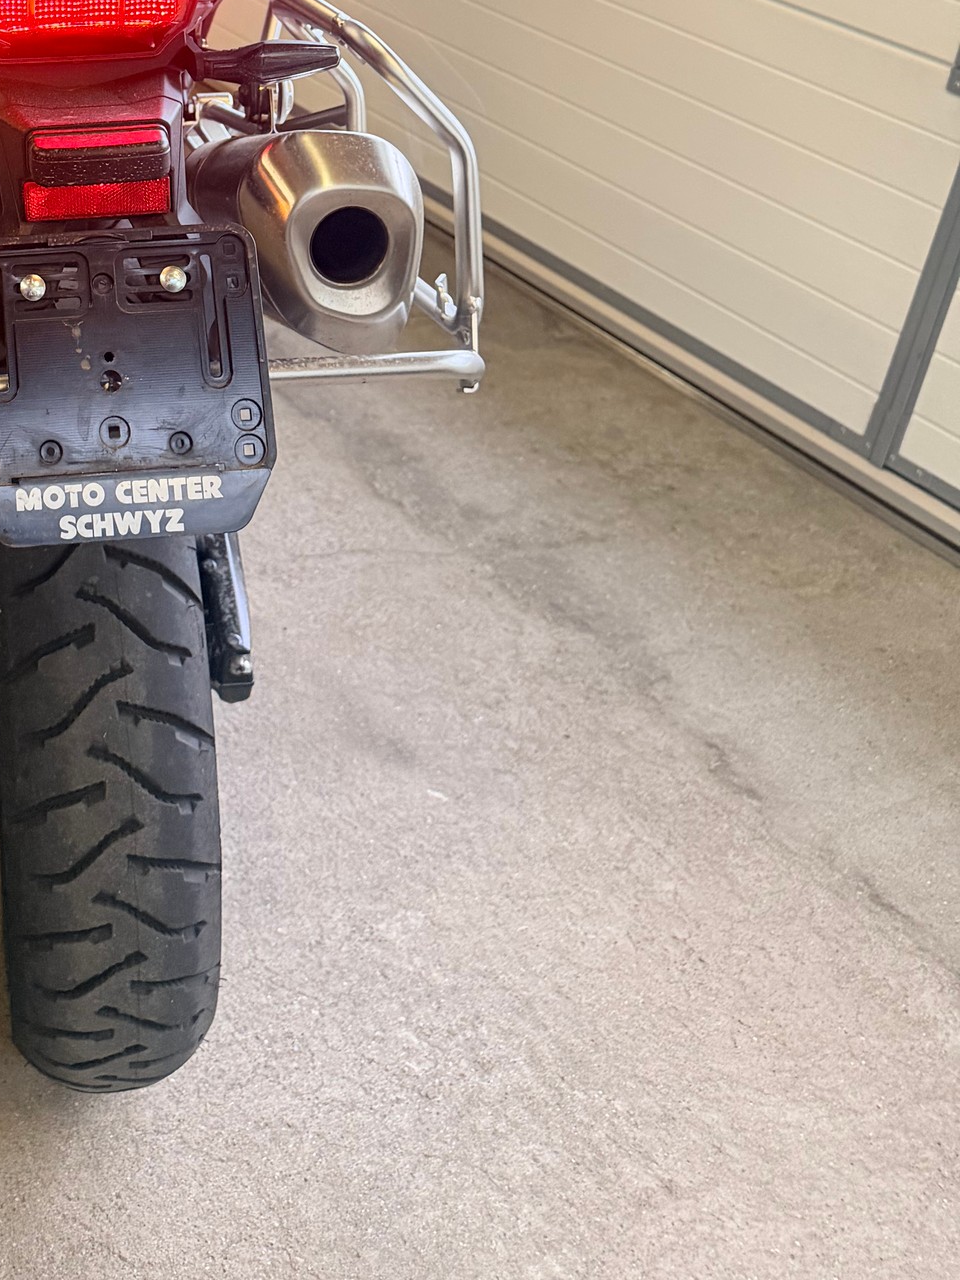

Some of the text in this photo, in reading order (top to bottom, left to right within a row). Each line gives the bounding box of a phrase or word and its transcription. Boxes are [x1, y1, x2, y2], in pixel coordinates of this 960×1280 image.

[15, 475, 224, 512] MOTO CENTER
[59, 508, 185, 540] SCHWYZ
